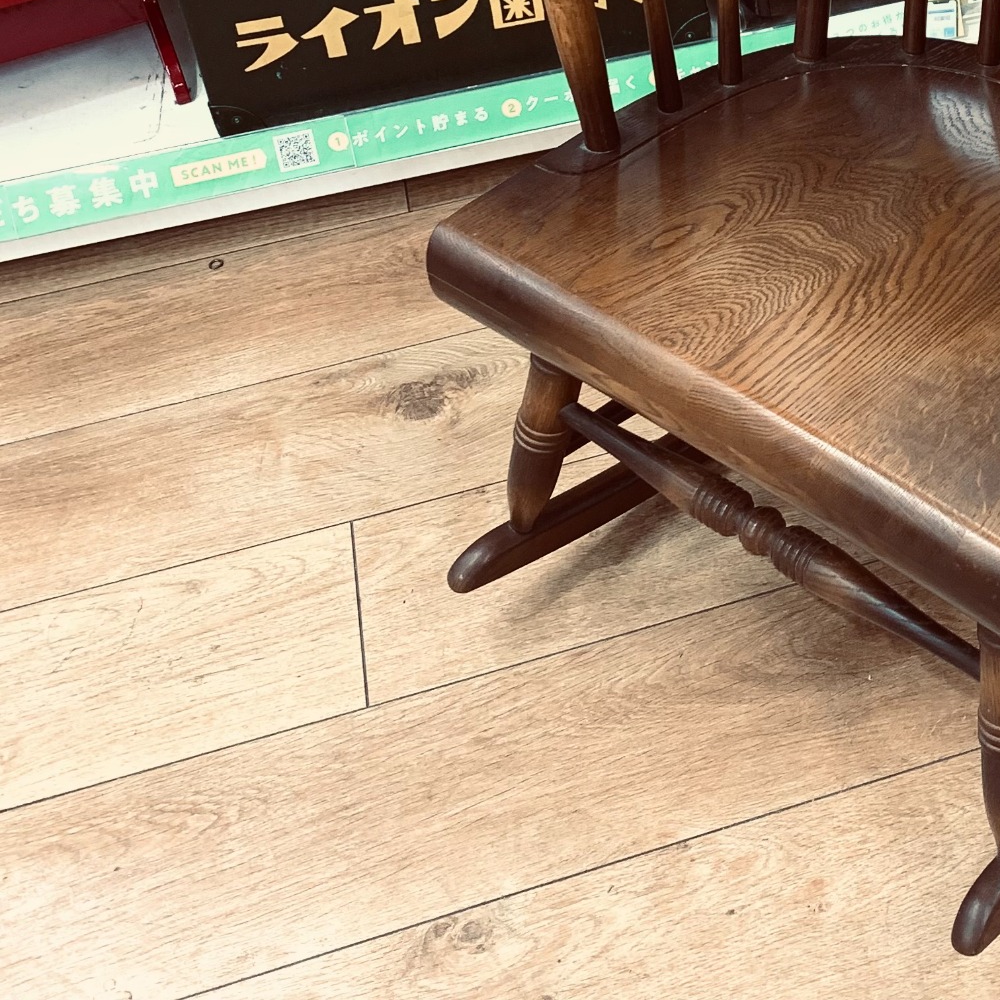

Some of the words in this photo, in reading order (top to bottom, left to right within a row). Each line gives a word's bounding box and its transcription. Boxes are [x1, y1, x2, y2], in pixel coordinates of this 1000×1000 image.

[352, 106, 489, 148] ポイント貯まる
[181, 162, 223, 181] SCAN
